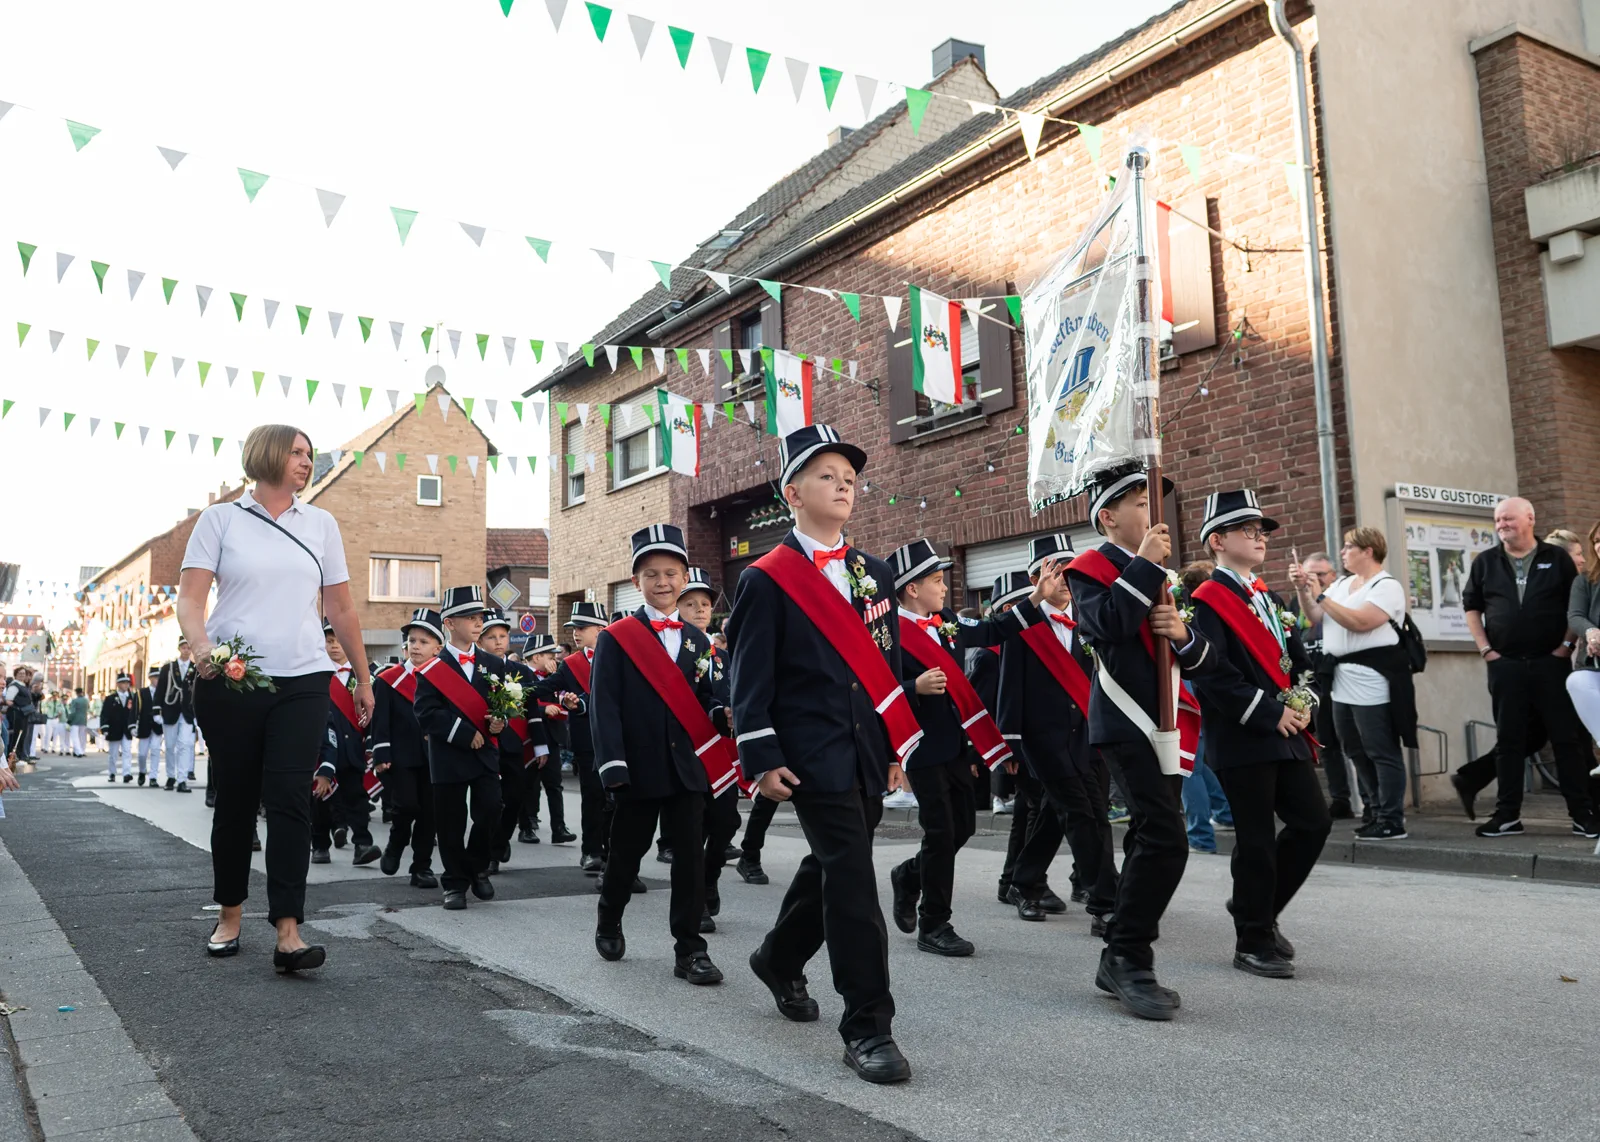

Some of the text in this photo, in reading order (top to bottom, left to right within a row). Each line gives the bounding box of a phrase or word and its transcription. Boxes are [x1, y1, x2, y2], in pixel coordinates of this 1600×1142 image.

[1047, 311, 1109, 365] orfknben
[1054, 432, 1096, 464] Gusf
[1413, 486, 1495, 506] BSV GUSTORF
